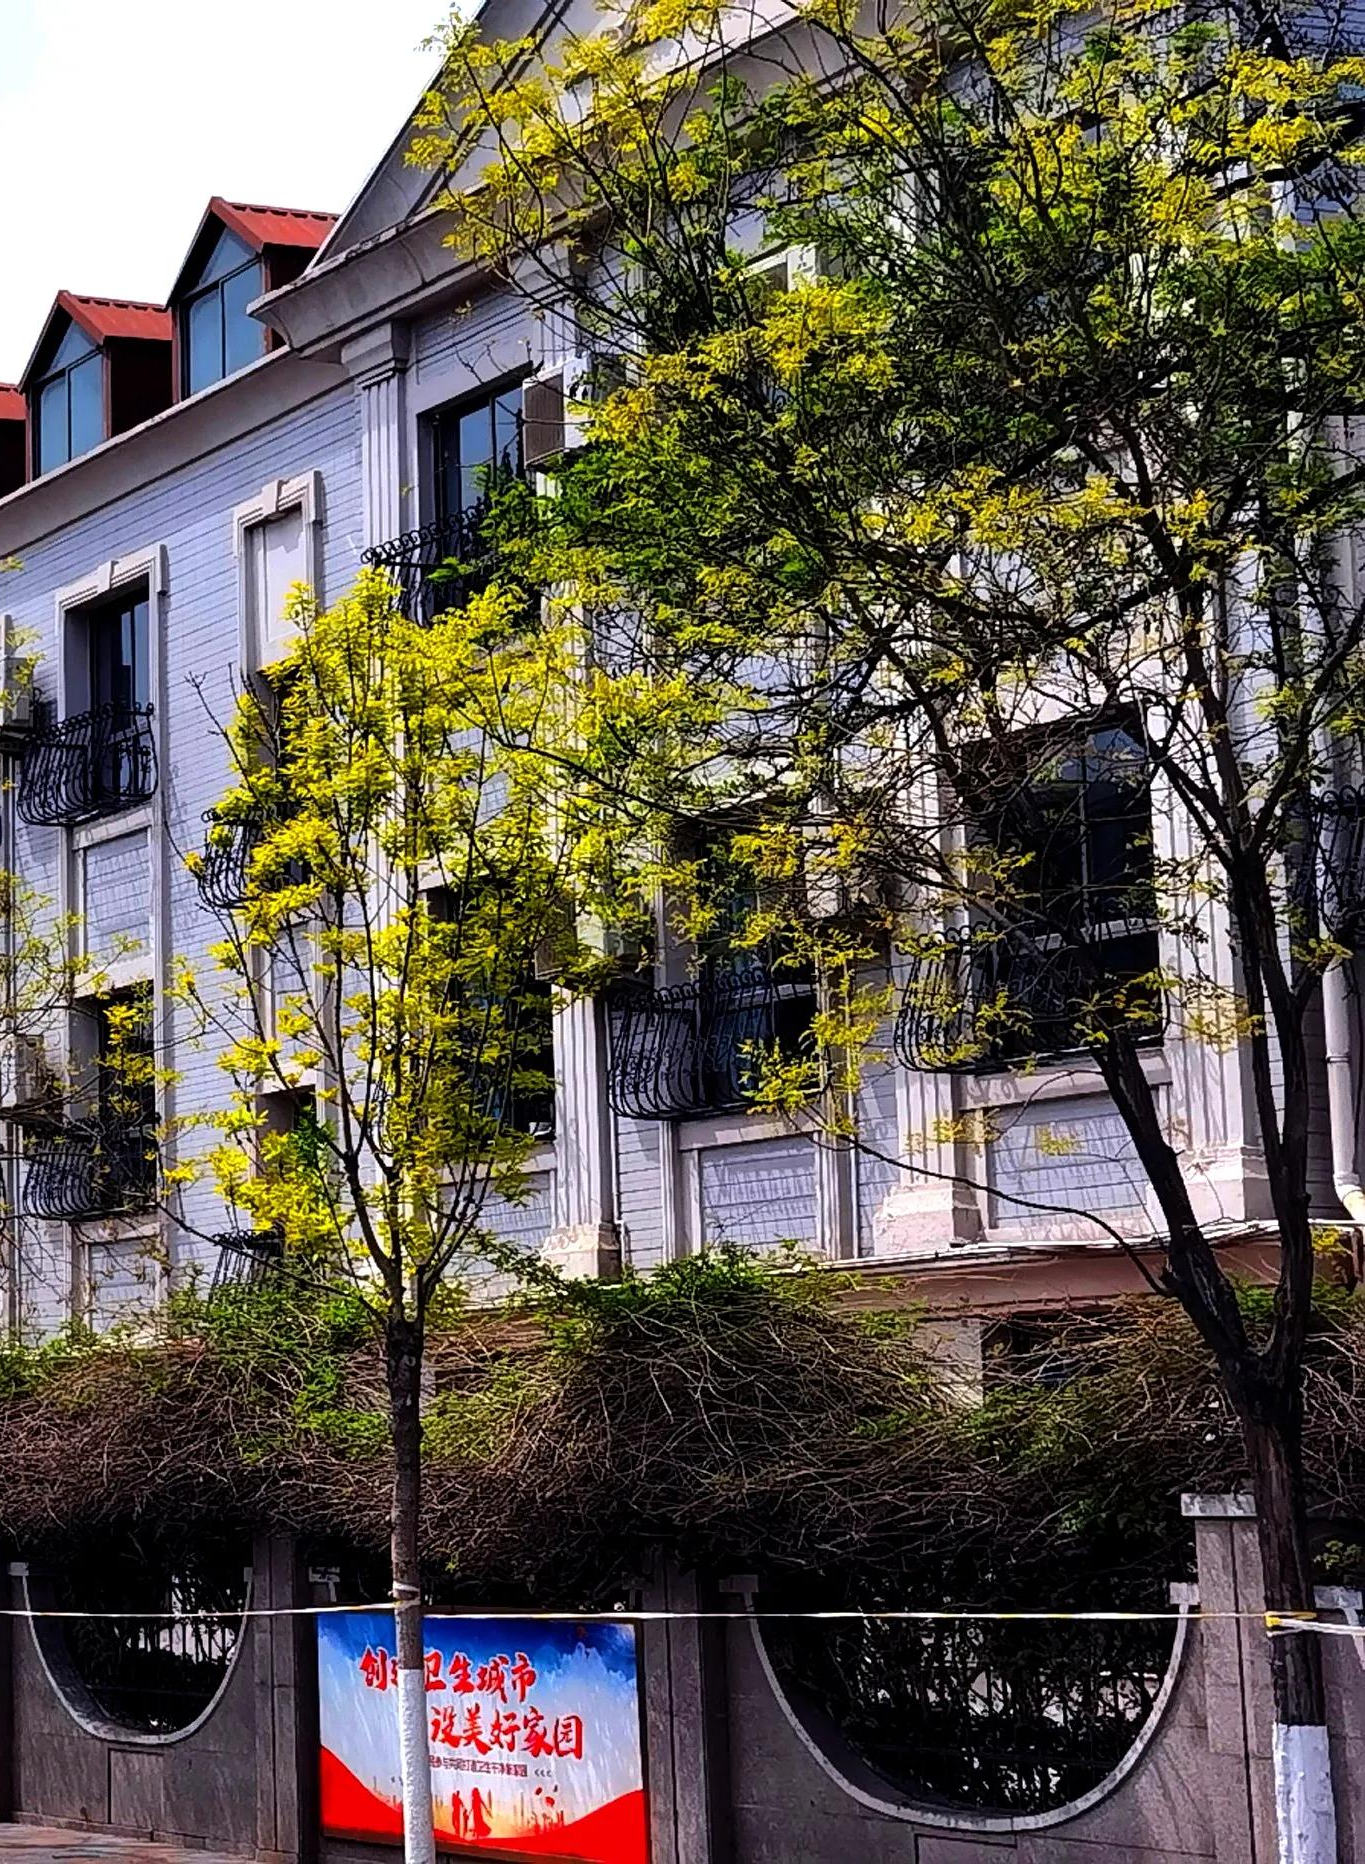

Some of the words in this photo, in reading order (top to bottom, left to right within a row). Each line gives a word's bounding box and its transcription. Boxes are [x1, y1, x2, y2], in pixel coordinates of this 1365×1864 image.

[360, 1648, 536, 1702] 创卫生城市
